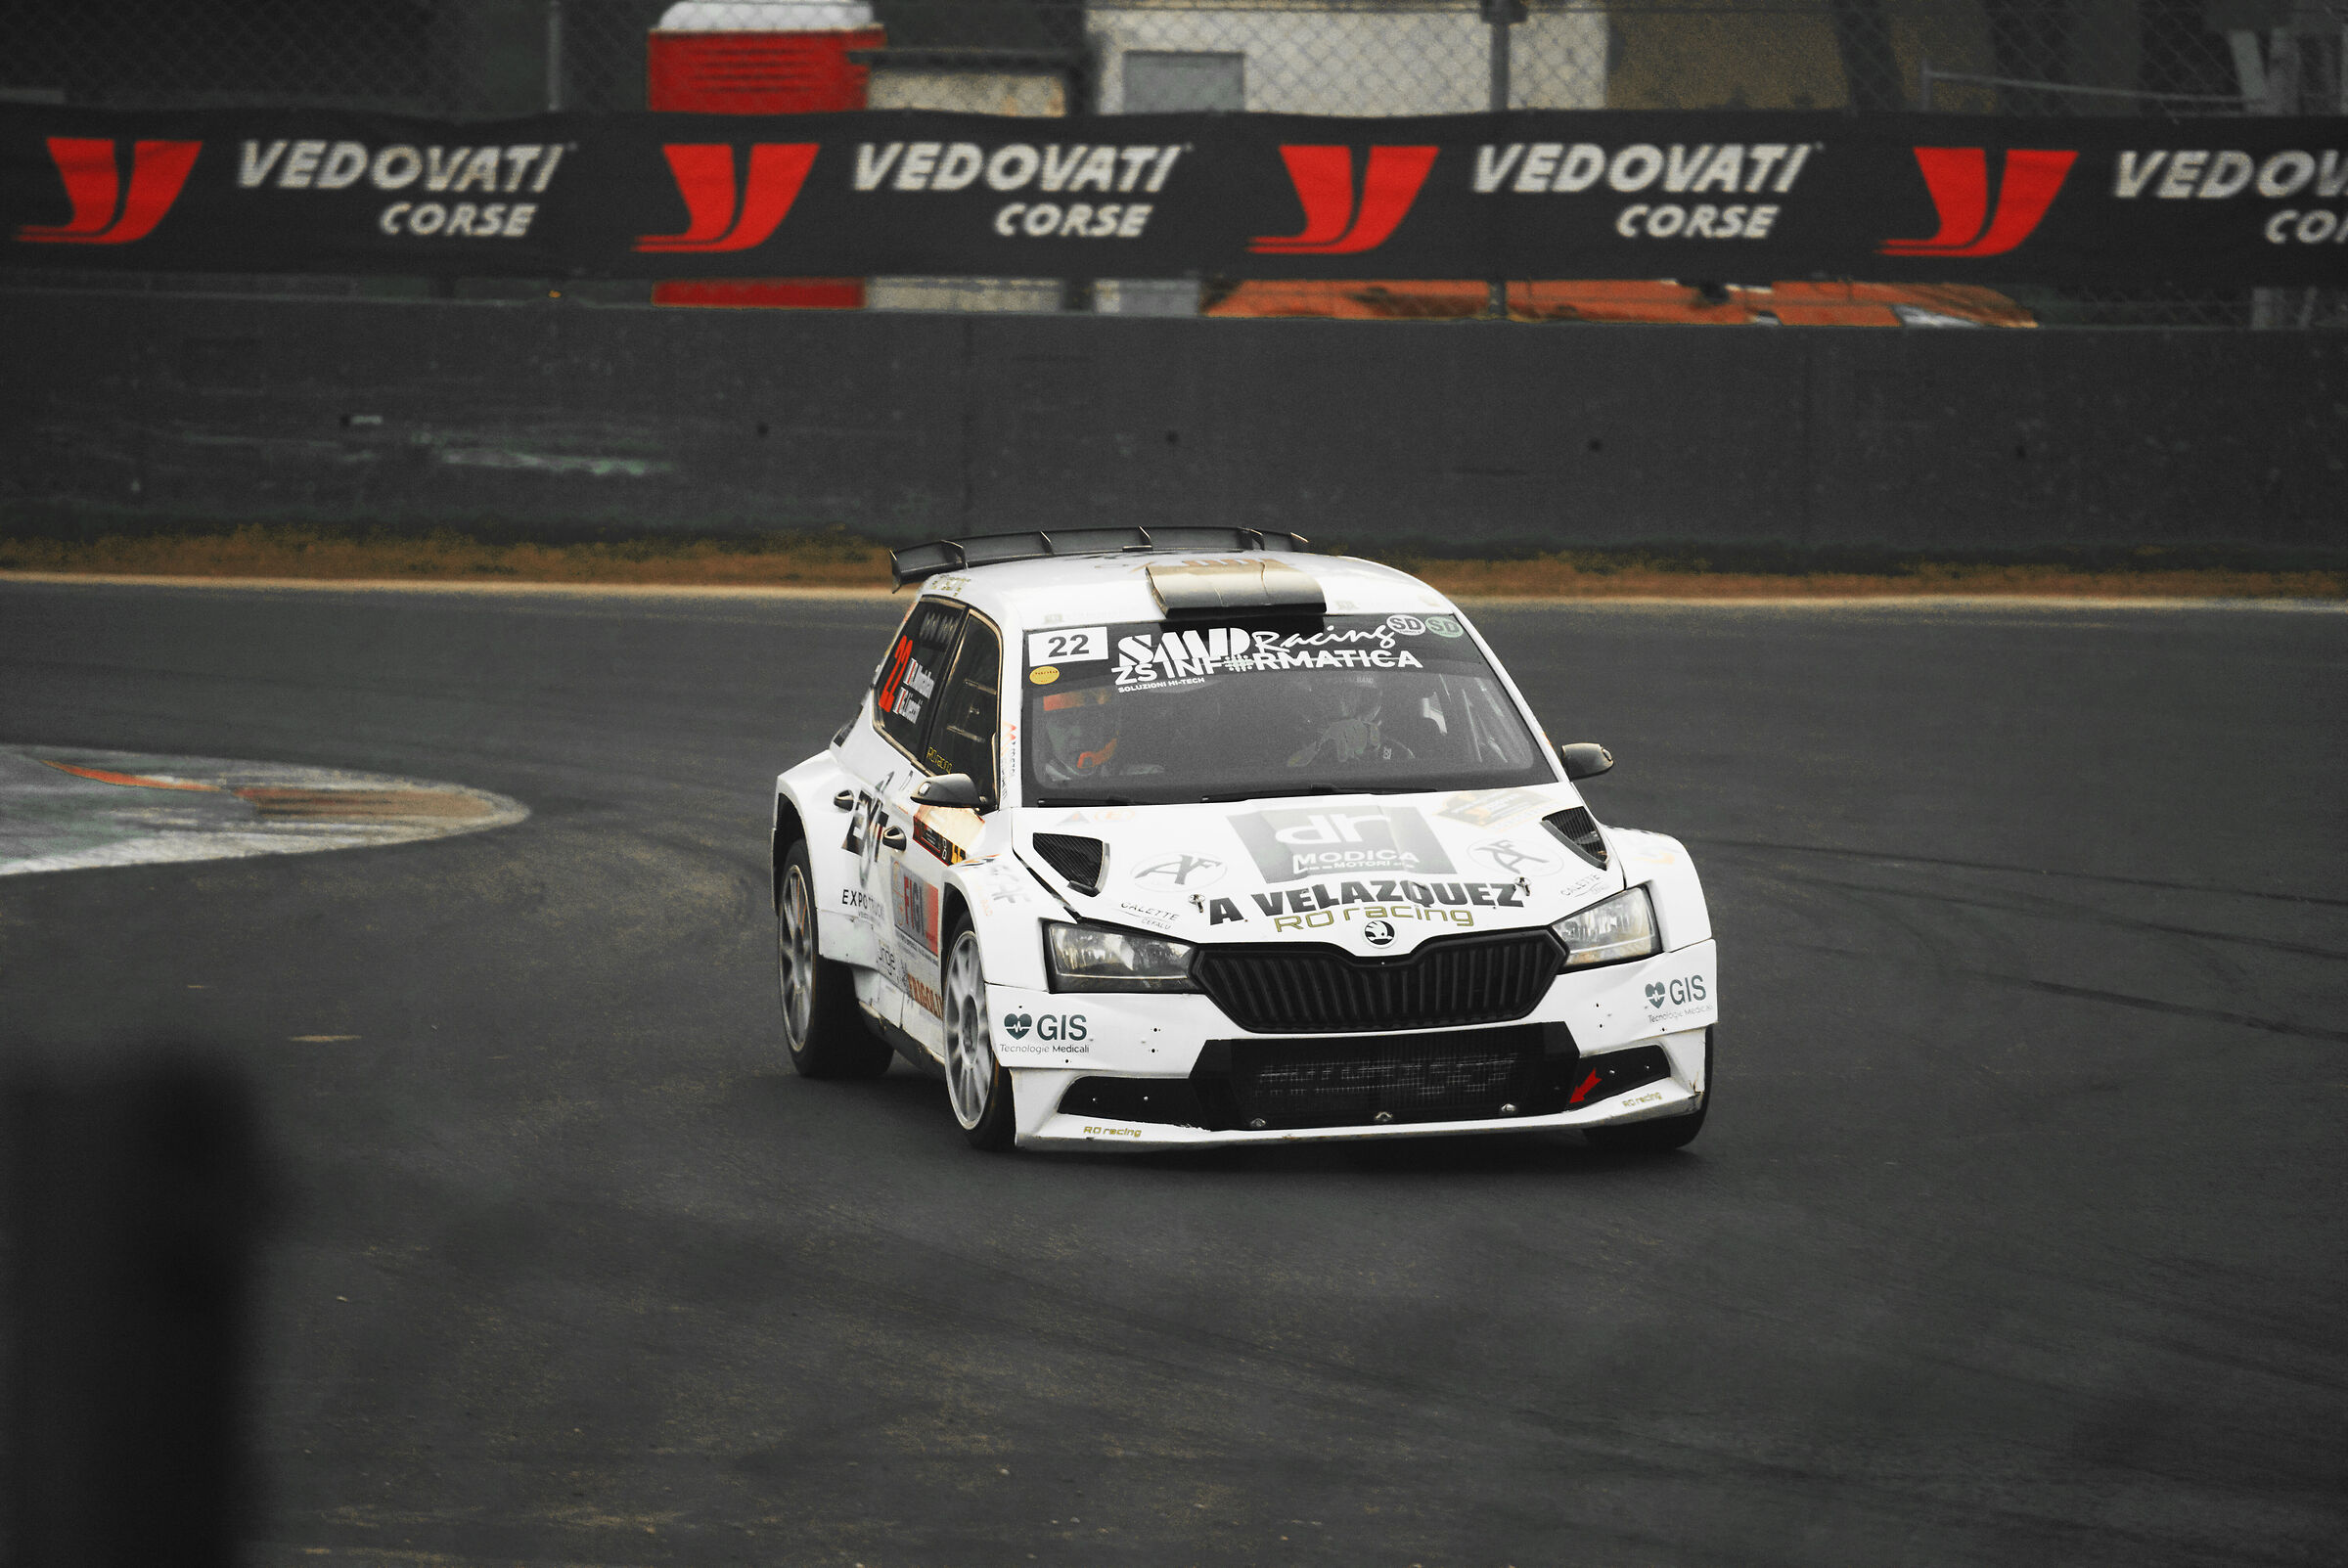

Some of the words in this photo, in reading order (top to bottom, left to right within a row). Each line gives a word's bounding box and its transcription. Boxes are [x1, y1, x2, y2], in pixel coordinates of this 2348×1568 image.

[240, 141, 564, 193] VEDOVATI
[855, 141, 1182, 193] VEDOVATI
[1473, 143, 1810, 193] VEDOVATI
[2115, 150, 2348, 199] VEDOV
[381, 202, 537, 237] CORSE
[994, 202, 1153, 237] CORSE
[1616, 203, 1780, 238] CORSE
[1389, 617, 1422, 630] SD
[1428, 619, 1460, 633] SD
[1048, 634, 1090, 657] 22
[1252, 625, 1396, 653] Racing
[879, 635, 913, 712] 22
[1111, 663, 1157, 685] ZS
[1163, 650, 1423, 679] INFORMATICA
[1118, 681, 1167, 694] SOLUZIONI
[1168, 677, 1205, 687] HI-TECH
[1292, 849, 1420, 867] MODICA
[1334, 860, 1390, 869] MOTORI
[1251, 880, 1524, 917] VELAZQUEZ
[1274, 910, 1334, 932] RO
[1343, 906, 1474, 926] racing
[1669, 975, 1706, 1006] GIS
[1037, 1014, 1088, 1041] GIS
[1000, 1044, 1050, 1054] Tecnologie
[1053, 1044, 1090, 1053] Medicali
[1104, 1127, 1143, 1138] racing
